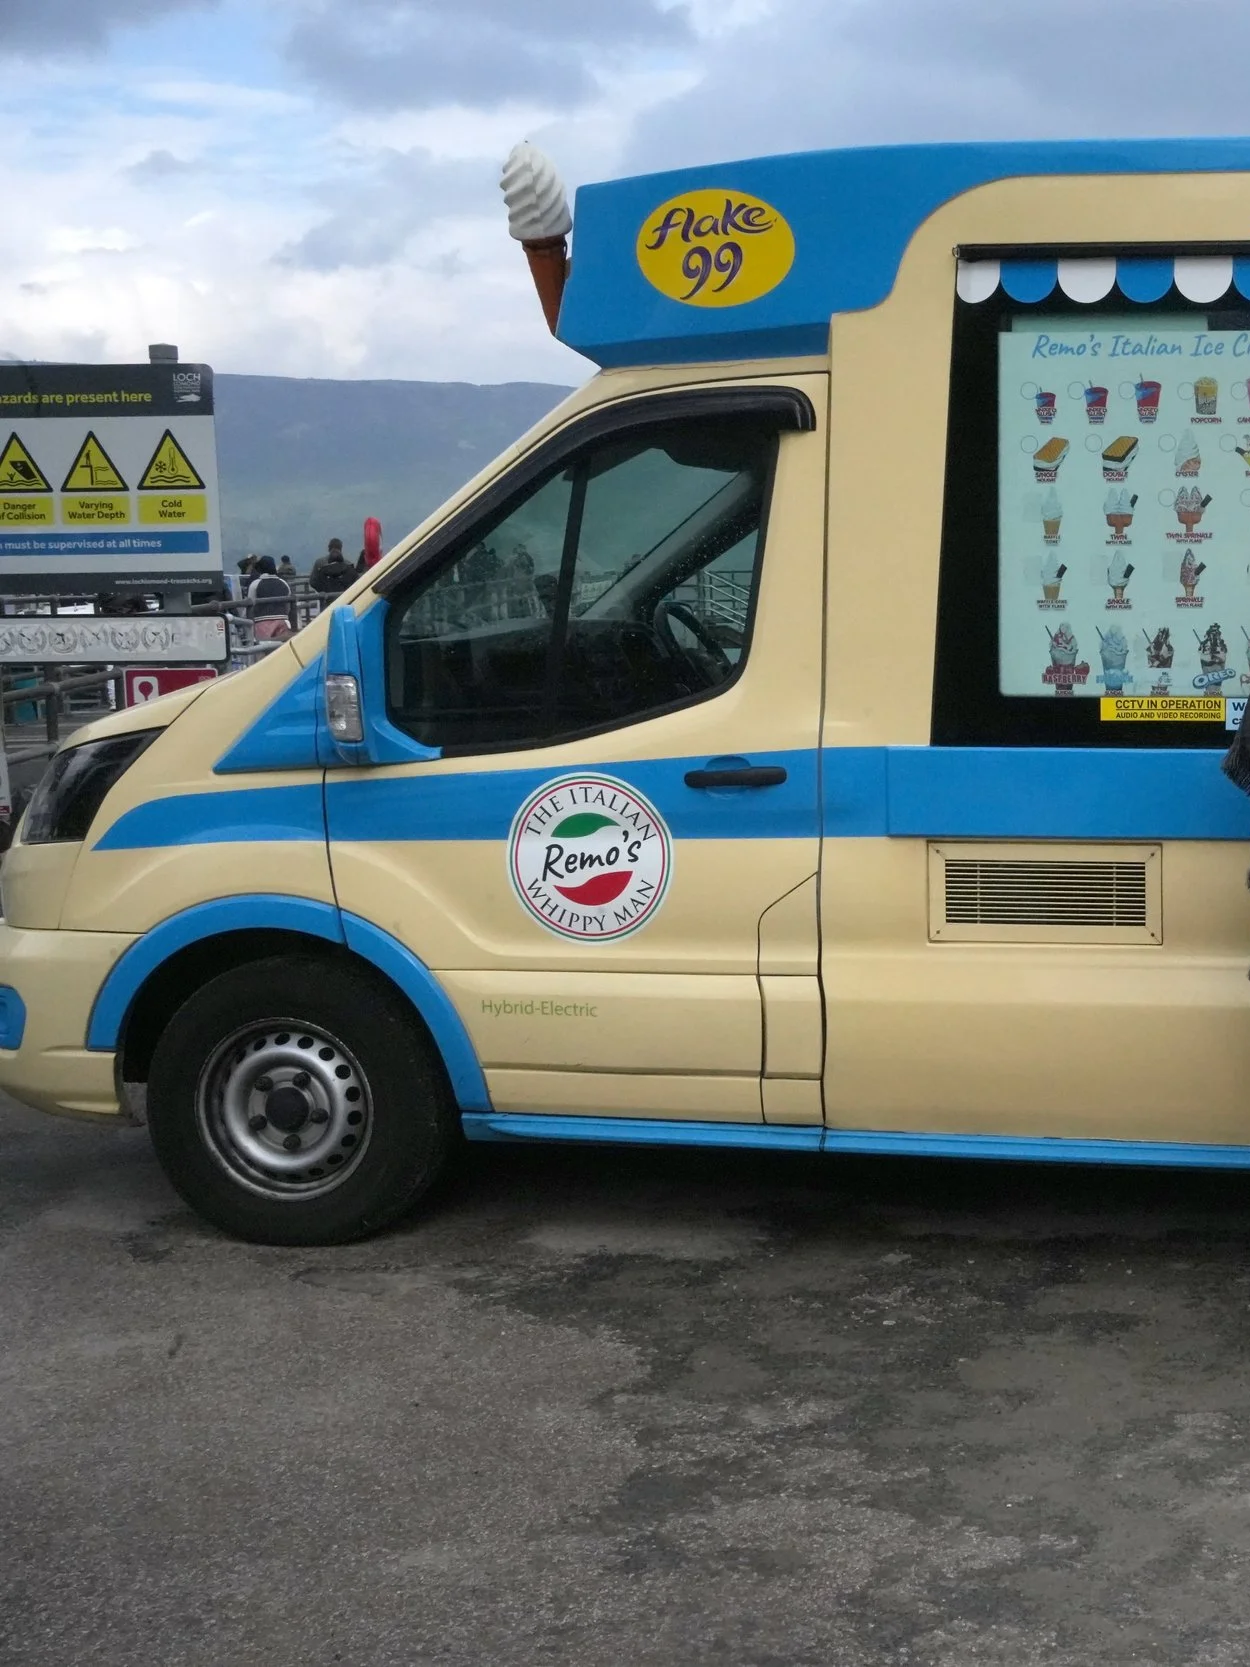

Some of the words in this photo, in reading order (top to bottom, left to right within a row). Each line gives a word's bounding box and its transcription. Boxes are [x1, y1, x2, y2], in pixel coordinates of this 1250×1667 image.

[680, 242, 743, 300] 99
[1032, 334, 1102, 359] Remo's
[1108, 334, 1182, 357] Italian
[1190, 334, 1225, 357] Ice
[173, 373, 200, 381] LOCH
[0, 391, 38, 404] zards
[41, 394, 64, 404] are
[66, 391, 118, 406] present
[121, 389, 152, 403] here
[3, 502, 37, 512] Danger
[78, 501, 114, 511] Varying
[161, 499, 183, 508] Cold
[7, 511, 47, 520] Collision
[68, 511, 96, 520] Water
[97, 510, 126, 521] Depth
[158, 510, 187, 519] Water
[4, 541, 31, 550] must
[33, 540, 46, 549] be
[48, 539, 104, 551] supervised
[106, 539, 117, 548] at
[119, 539, 131, 548] all
[132, 539, 162, 548] times
[1193, 669, 1236, 689] OREO
[1115, 700, 1145, 709] CCTV
[1147, 700, 1157, 709] IN
[1161, 700, 1221, 709] OPERATION
[525, 796, 564, 837] THE
[569, 787, 657, 841] ITALIAN
[542, 829, 642, 882] Remo's
[527, 878, 606, 931] WHIPPY
[614, 880, 655, 926] MAN
[481, 1000, 599, 1018] Hybrid-Electric
